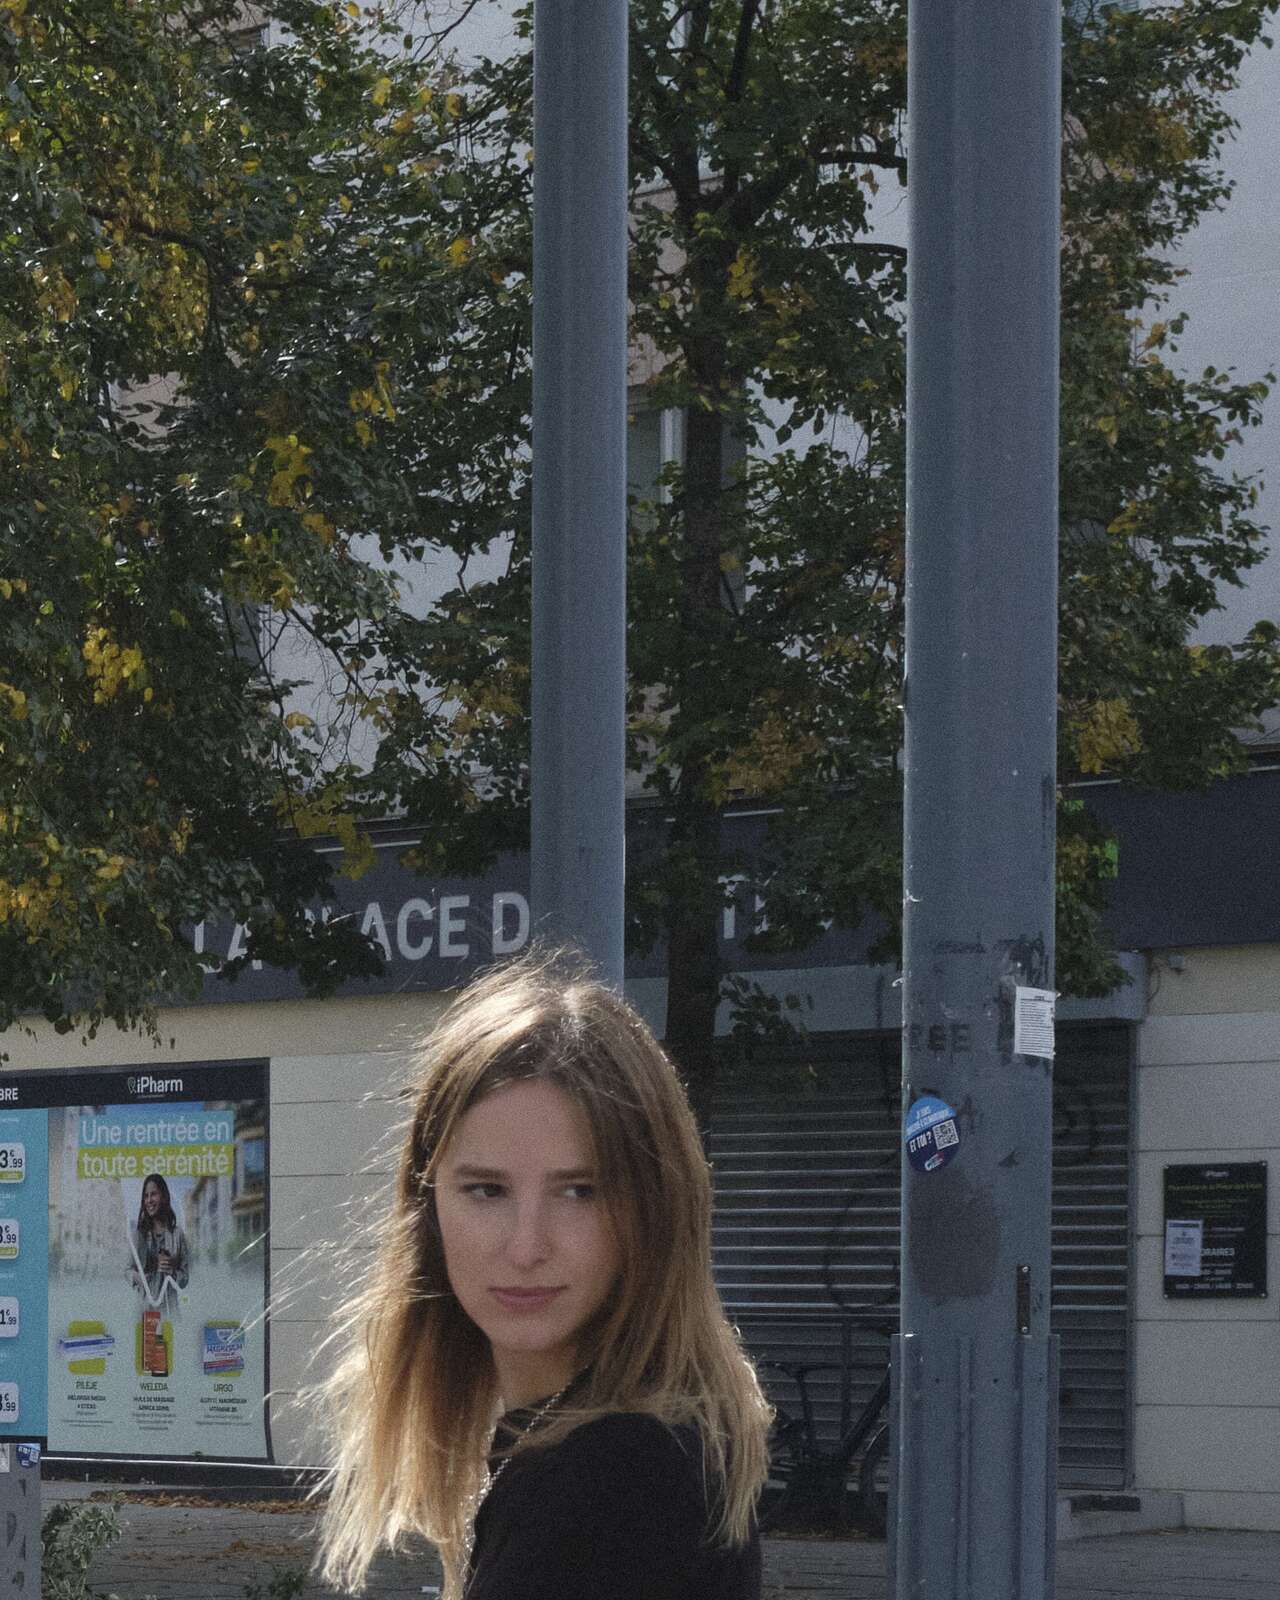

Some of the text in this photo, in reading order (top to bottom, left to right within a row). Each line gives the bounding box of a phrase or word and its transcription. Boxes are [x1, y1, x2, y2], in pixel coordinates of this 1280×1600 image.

[136, 1076, 184, 1094] iPharm
[82, 1115, 230, 1145] Une rentrée en
[82, 1147, 229, 1177] toute sérénité
[140, 1382, 169, 1392] WELEDA
[213, 1383, 234, 1393] URGO
